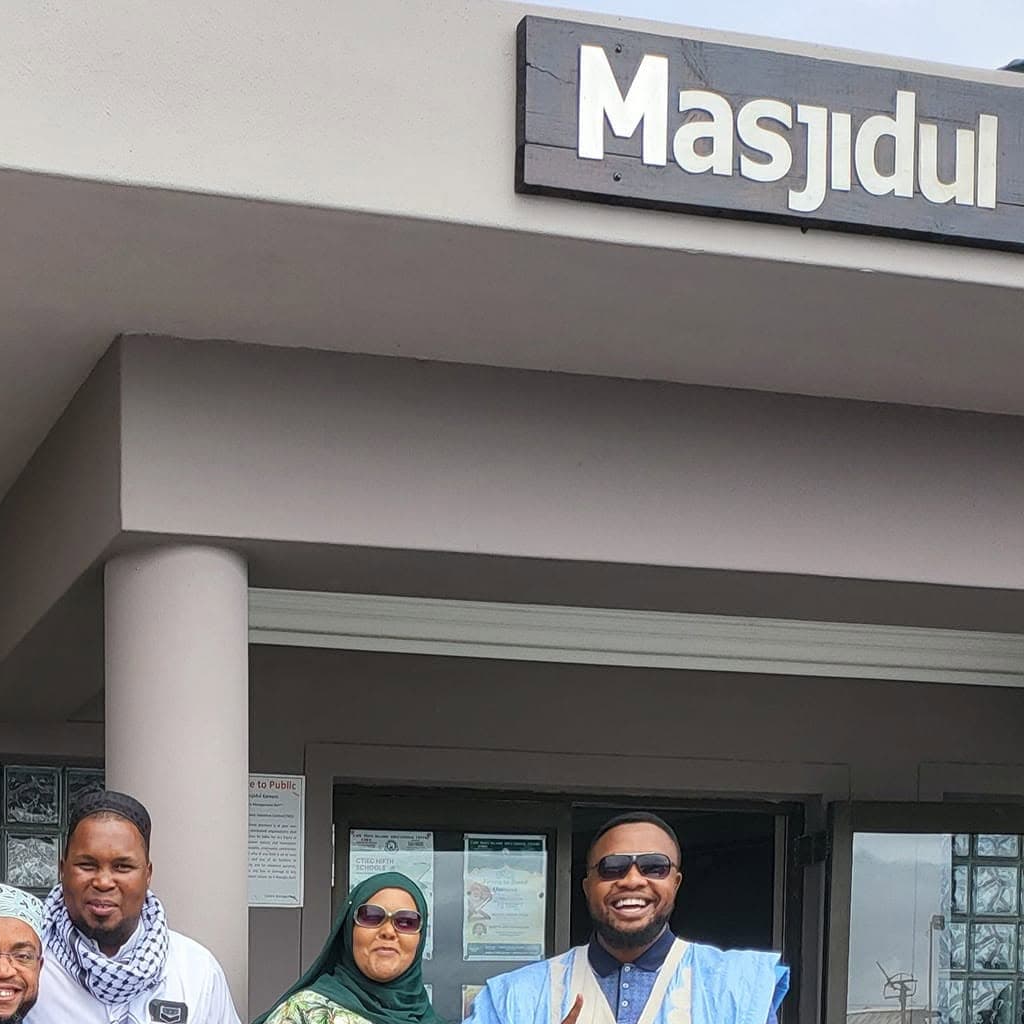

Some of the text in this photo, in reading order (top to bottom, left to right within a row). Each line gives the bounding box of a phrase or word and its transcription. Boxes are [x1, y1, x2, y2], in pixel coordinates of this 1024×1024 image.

[578, 44, 998, 212] Masjidul
[257, 780, 267, 789] to
[269, 780, 297, 790] Public
